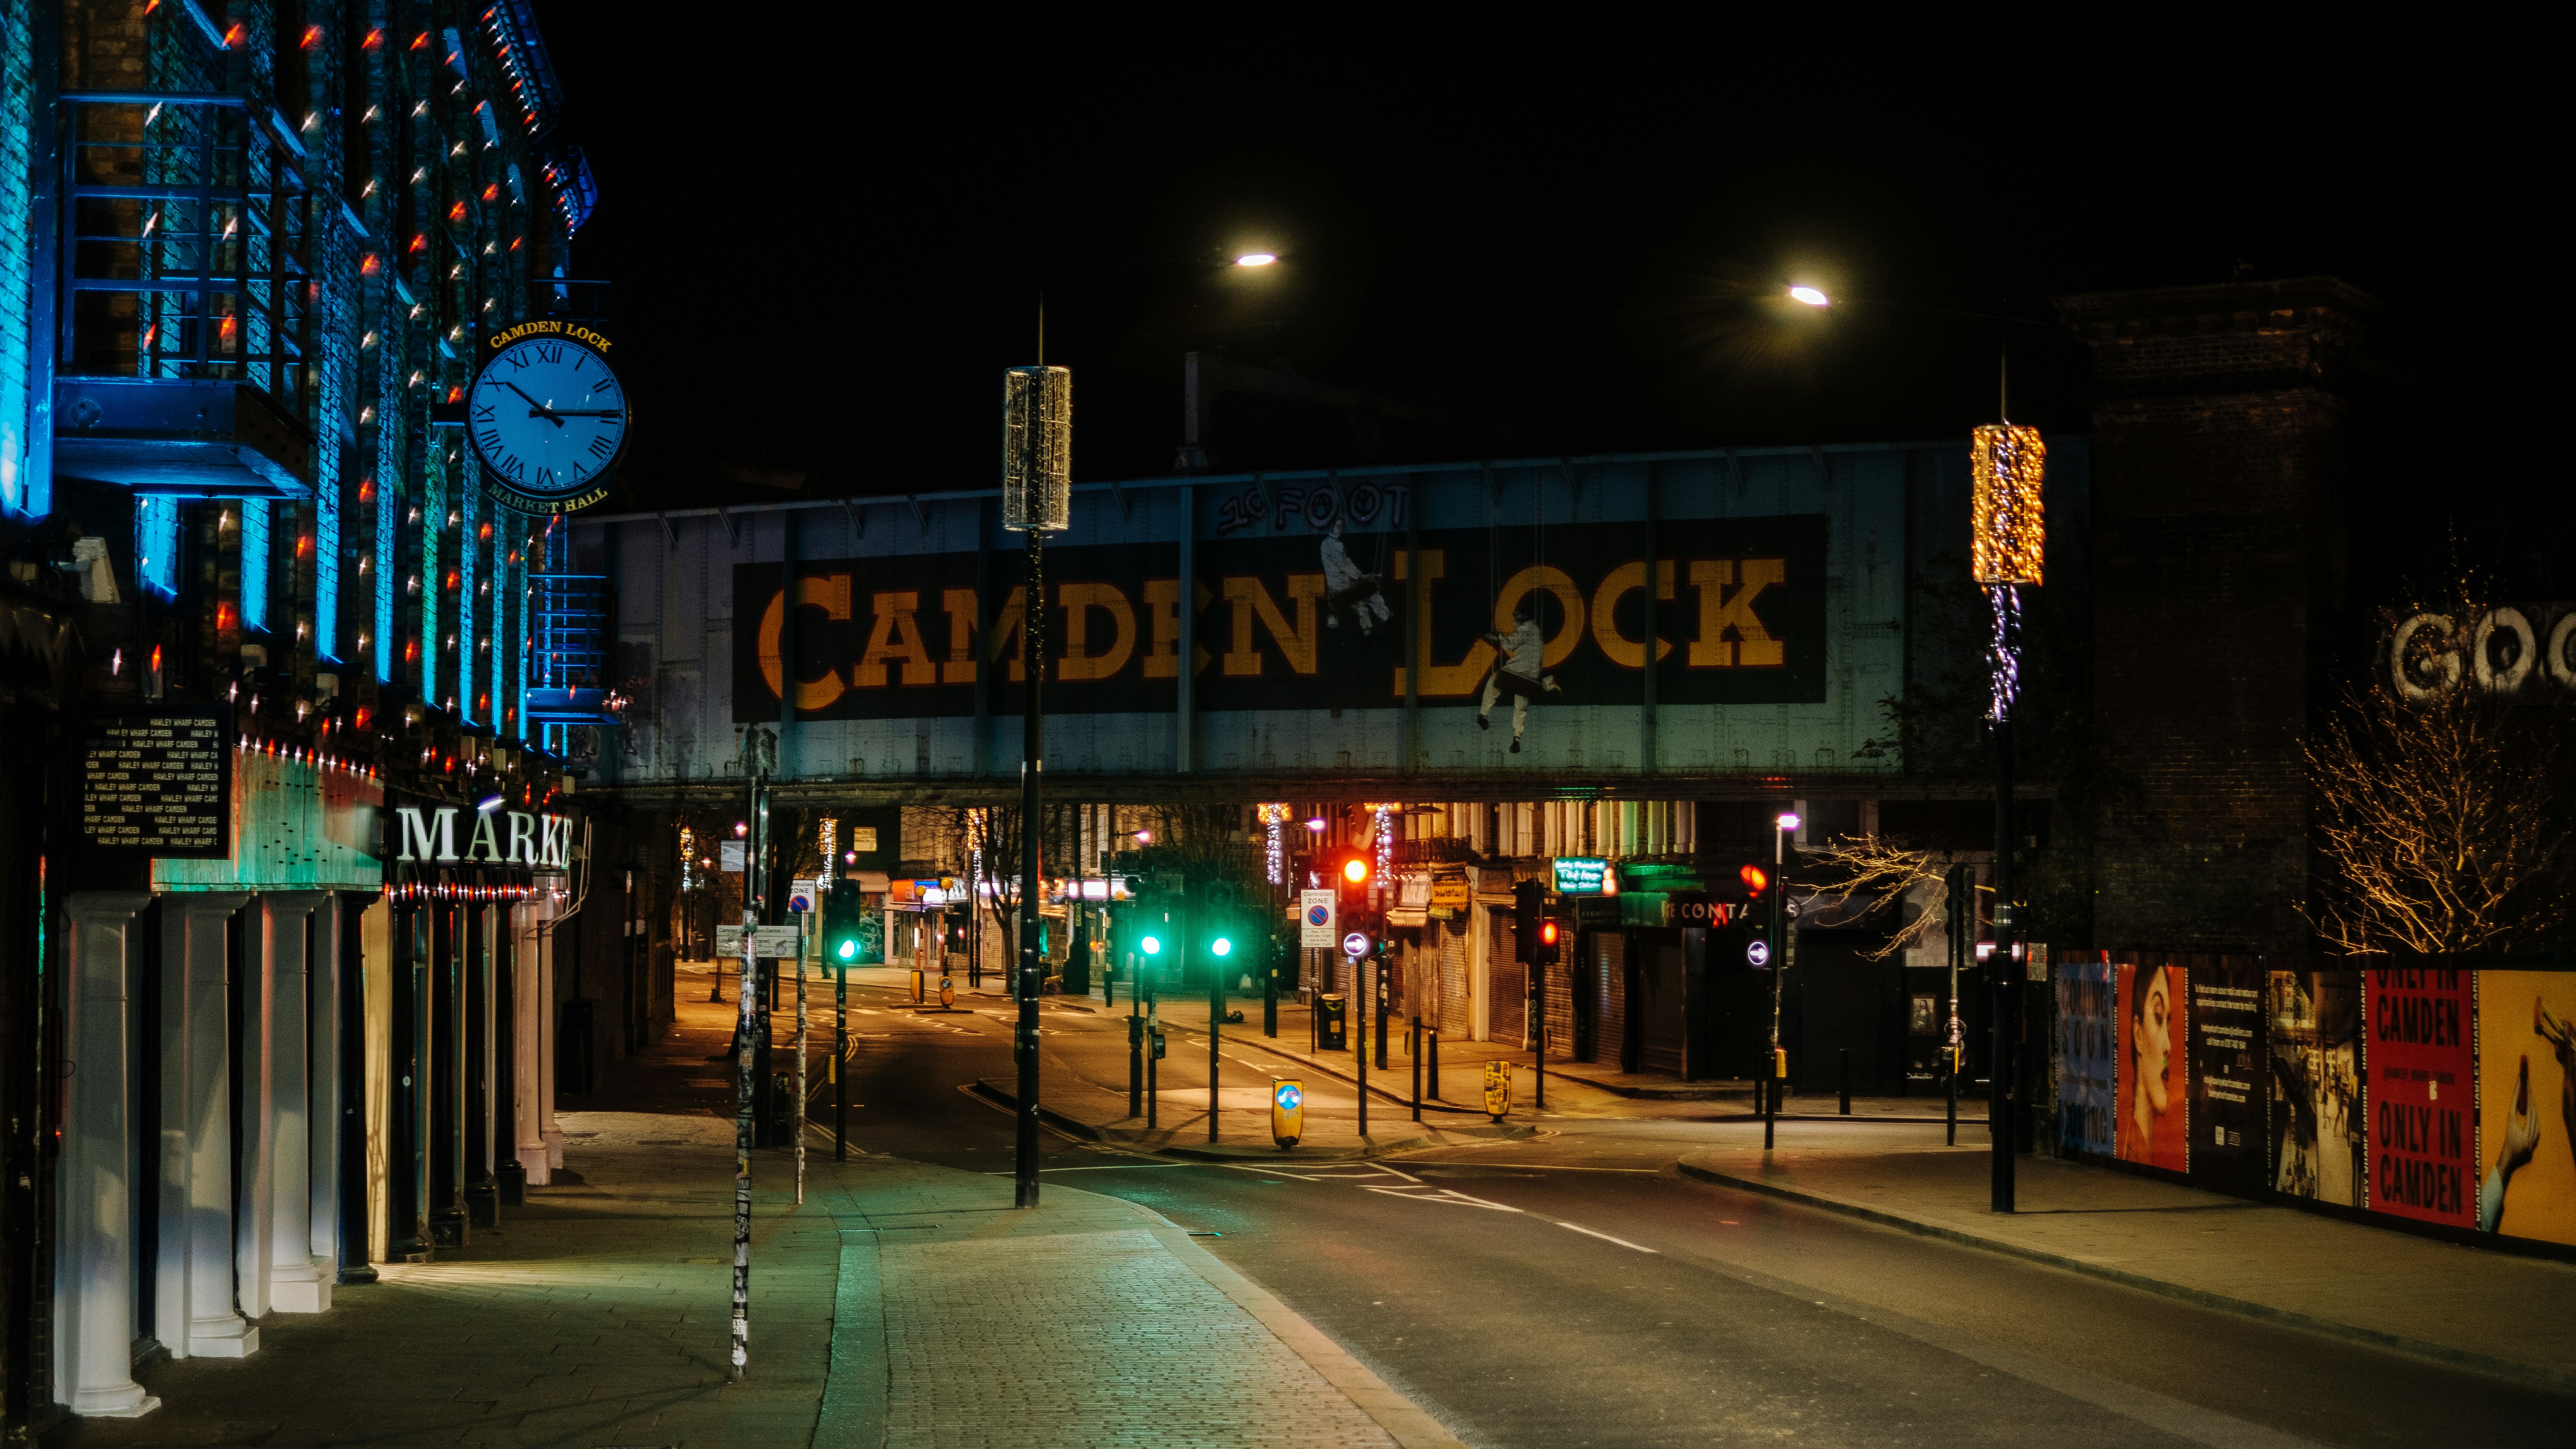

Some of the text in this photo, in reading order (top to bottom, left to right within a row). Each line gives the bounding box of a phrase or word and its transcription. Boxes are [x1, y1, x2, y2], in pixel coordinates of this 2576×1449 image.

[490, 321, 612, 352] CAMDEN LOCK
[488, 483, 608, 514] MARKET HALL
[756, 546, 1786, 711] CAMDEN LOCK
[2061, 1019, 2108, 1060] SOON
[2376, 994, 2460, 1047] CAMDEN
[2379, 1100, 2461, 1159] ONLY IN
[2379, 1154, 2462, 1215] CAMDEN
